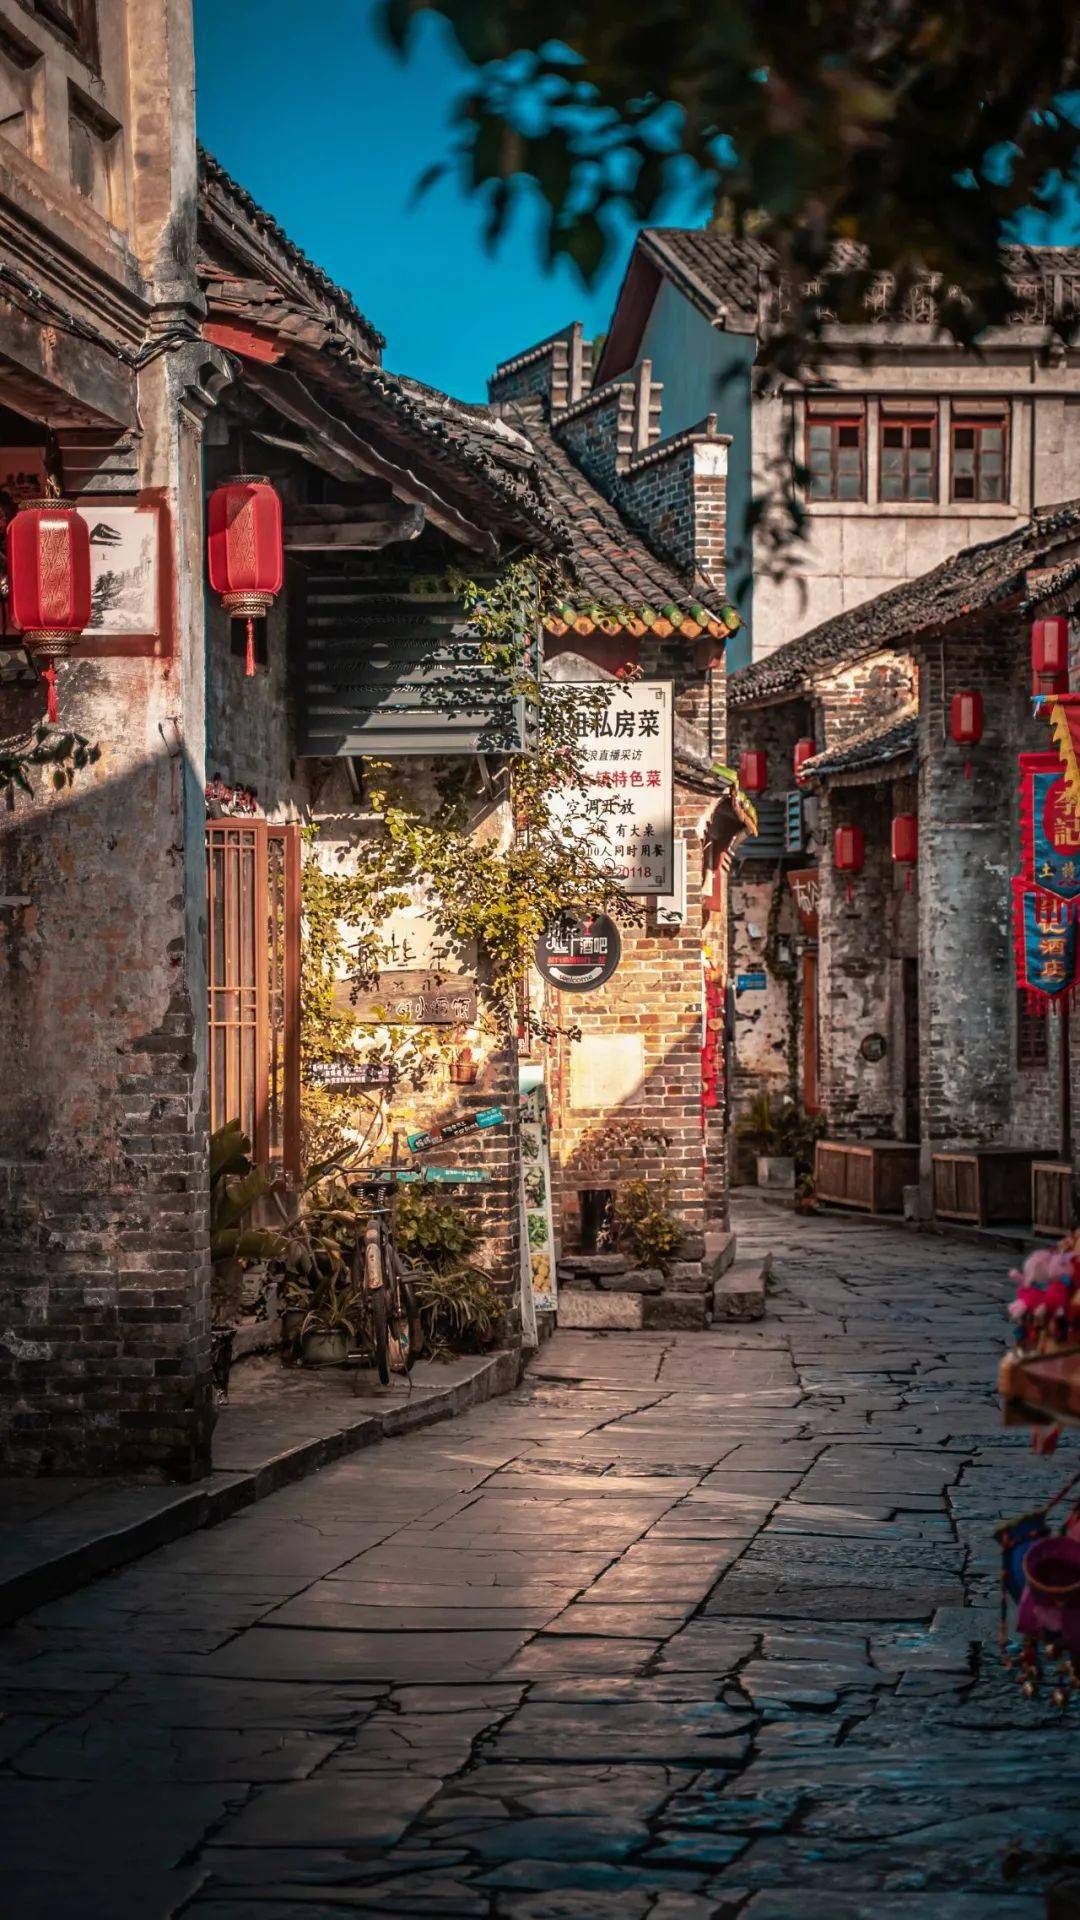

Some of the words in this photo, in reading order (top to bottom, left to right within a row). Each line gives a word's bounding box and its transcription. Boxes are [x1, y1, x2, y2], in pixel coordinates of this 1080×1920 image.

[551, 710, 660, 738] 姐私房菜
[566, 798, 636, 816] 空调开放
[616, 824, 656, 838] 有大桌
